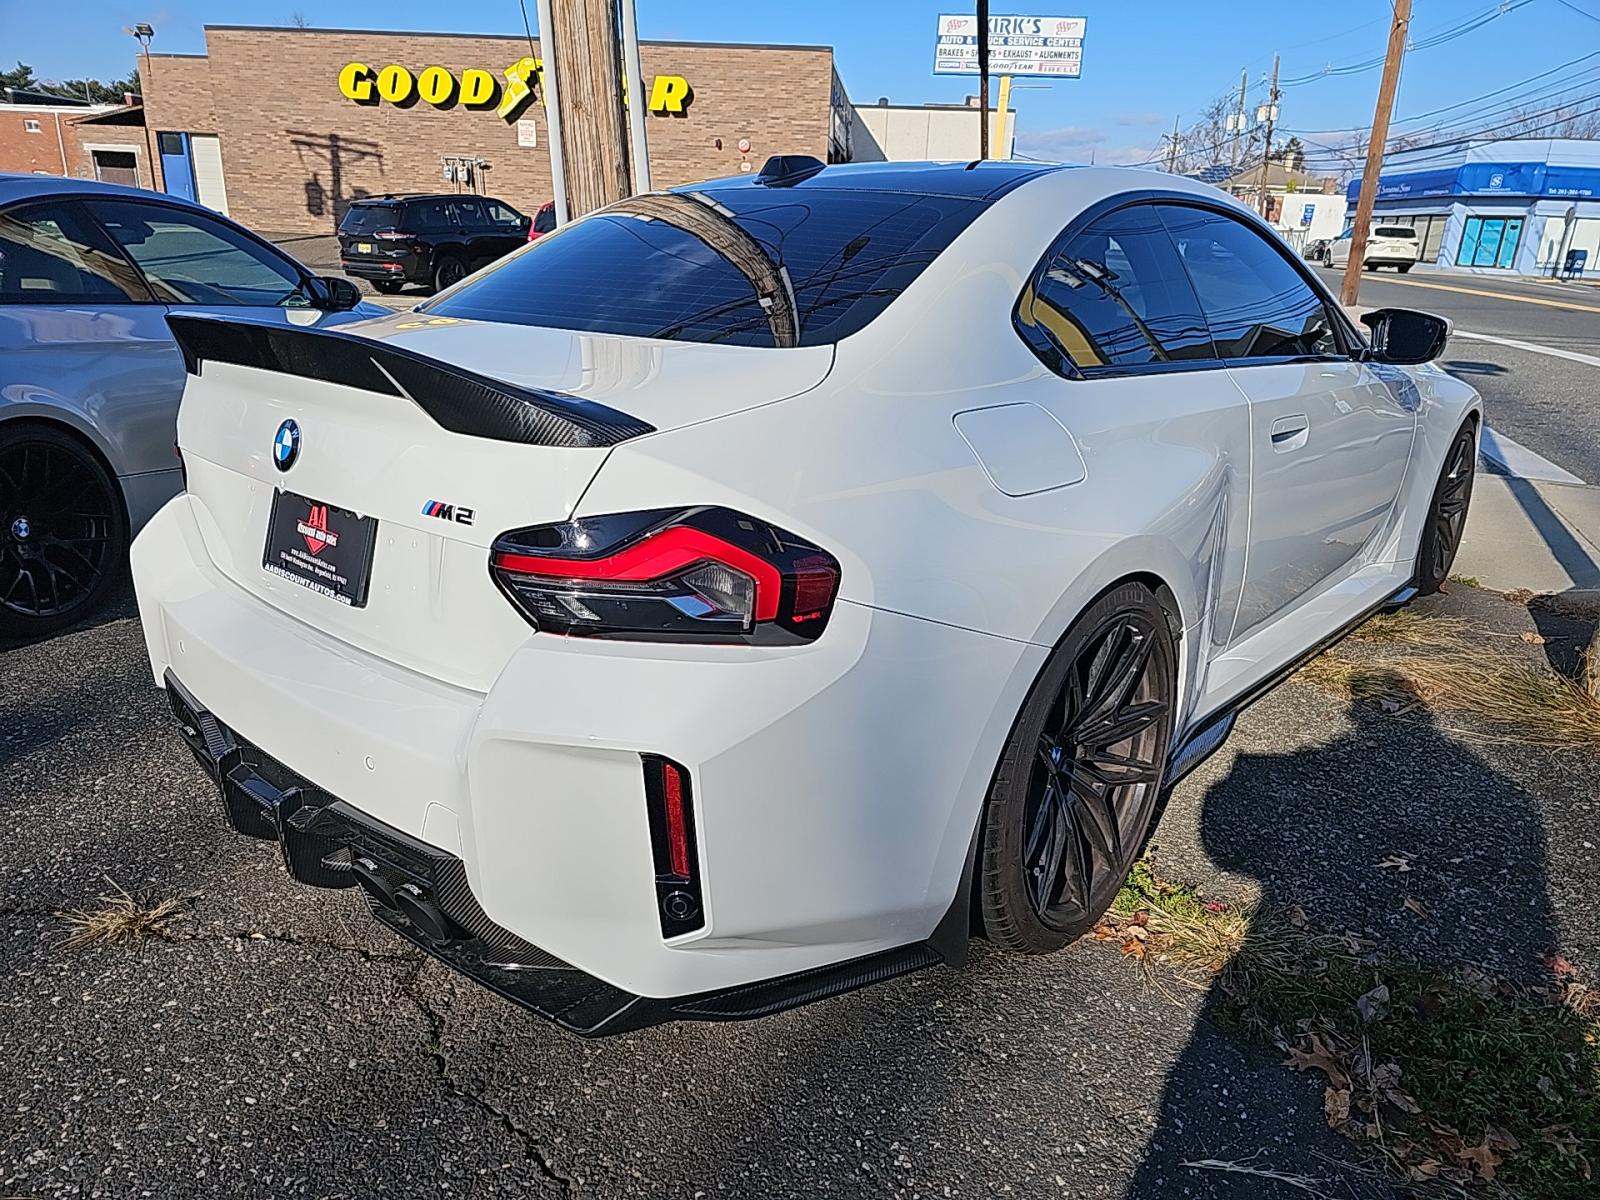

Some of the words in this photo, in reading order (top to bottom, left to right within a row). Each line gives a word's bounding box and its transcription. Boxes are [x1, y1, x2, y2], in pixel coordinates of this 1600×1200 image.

[940, 36, 963, 44] AUTO
[1008, 37, 1044, 46] SERVICE
[1047, 38, 1081, 47] CENTER
[938, 48, 964, 57] BRAKES
[1002, 49, 1033, 58] EXHAUST
[1039, 51, 1079, 60] ALIGNMENTS
